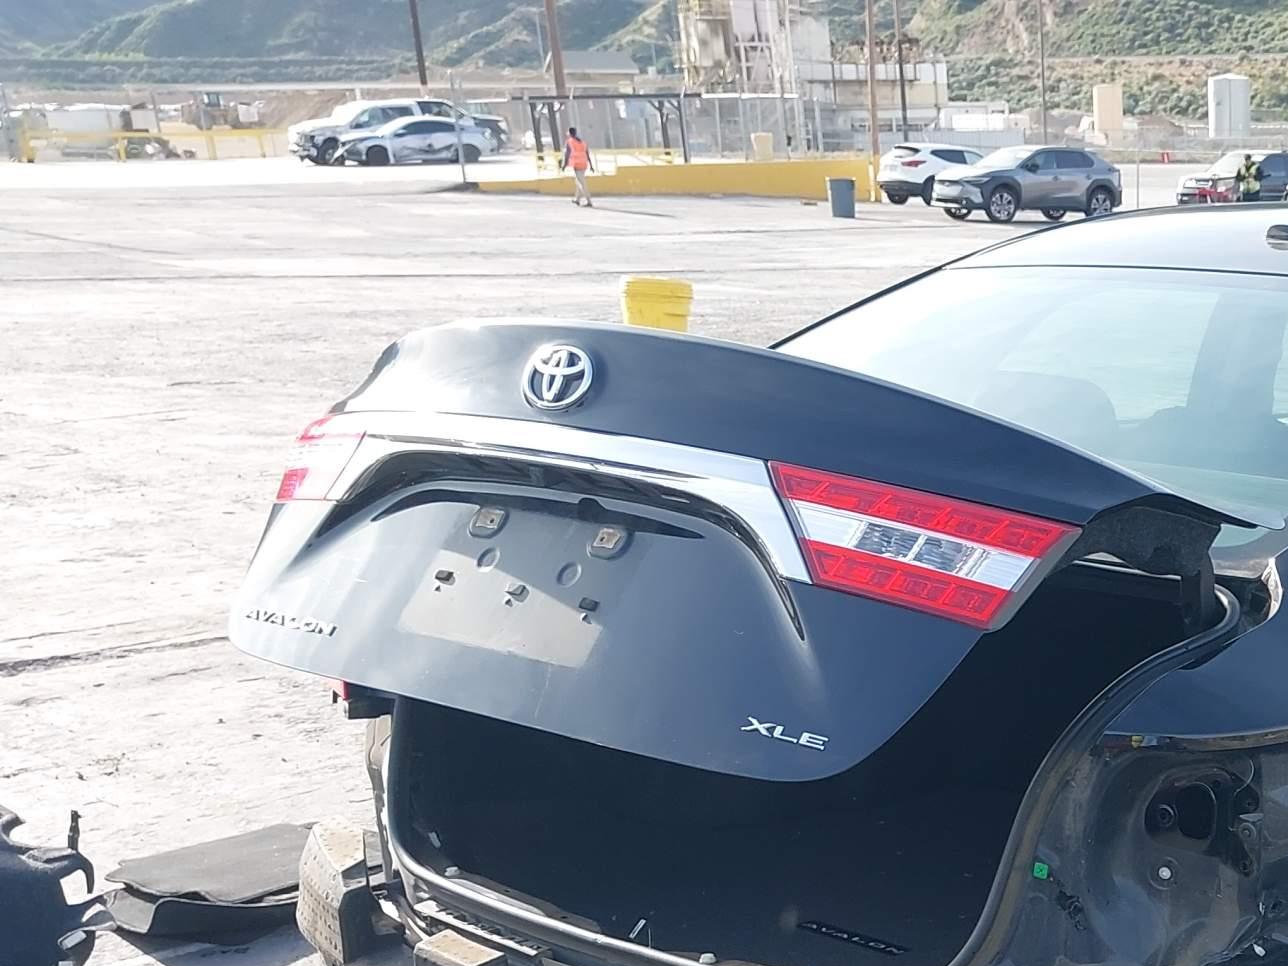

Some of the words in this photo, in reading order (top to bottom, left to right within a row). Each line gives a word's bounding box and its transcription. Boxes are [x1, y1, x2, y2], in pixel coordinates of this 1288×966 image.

[245, 609, 337, 637] AVALON
[740, 716, 829, 750] XLE
[799, 922, 905, 954] AVALON
